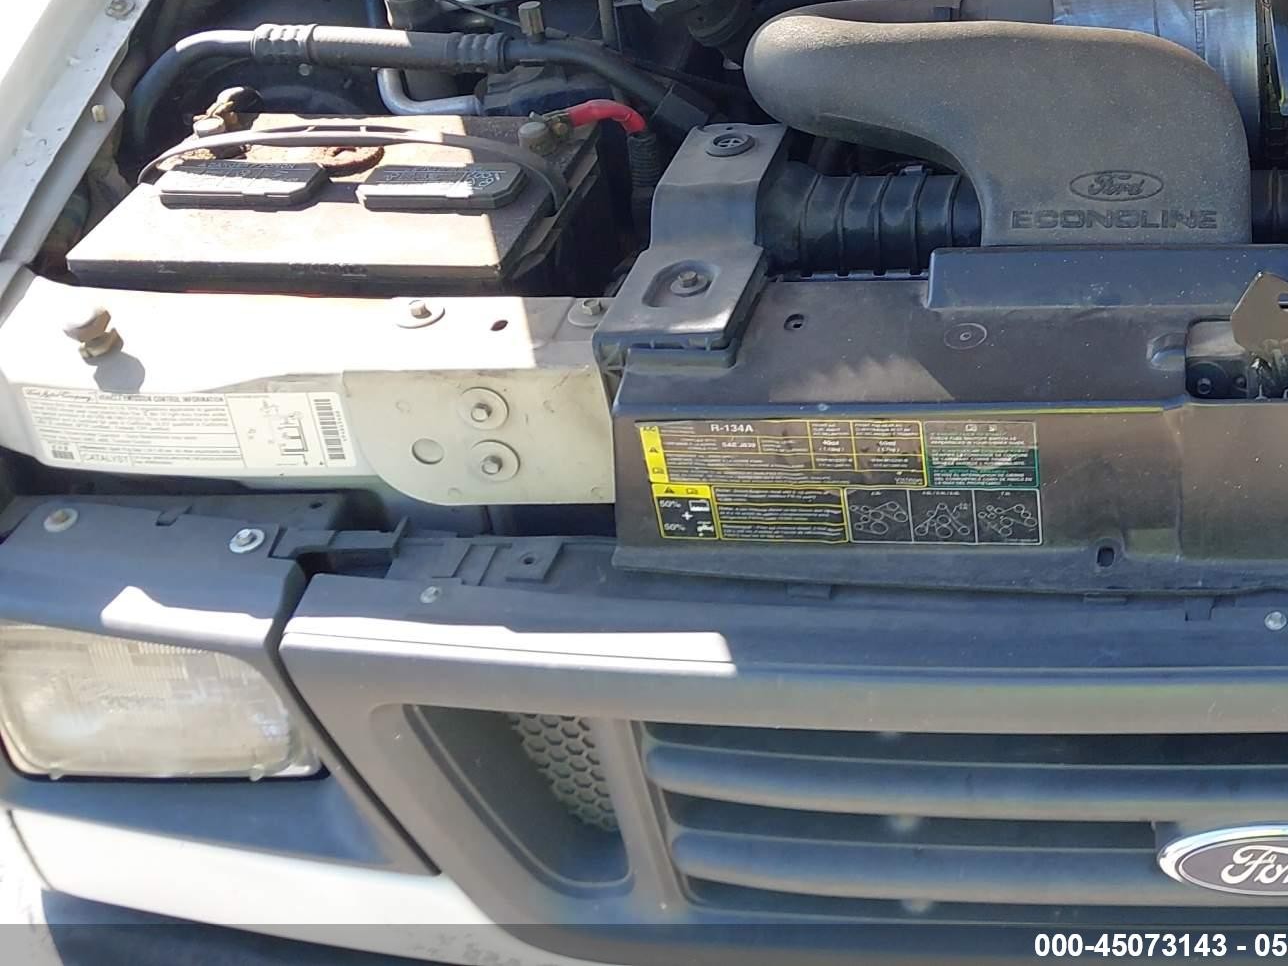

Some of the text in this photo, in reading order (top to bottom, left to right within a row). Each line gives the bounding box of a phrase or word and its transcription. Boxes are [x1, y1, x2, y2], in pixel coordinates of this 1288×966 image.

[1088, 173, 1145, 196] Ford
[1011, 209, 1218, 230] ECONOLINE
[710, 424, 754, 433] R-134A
